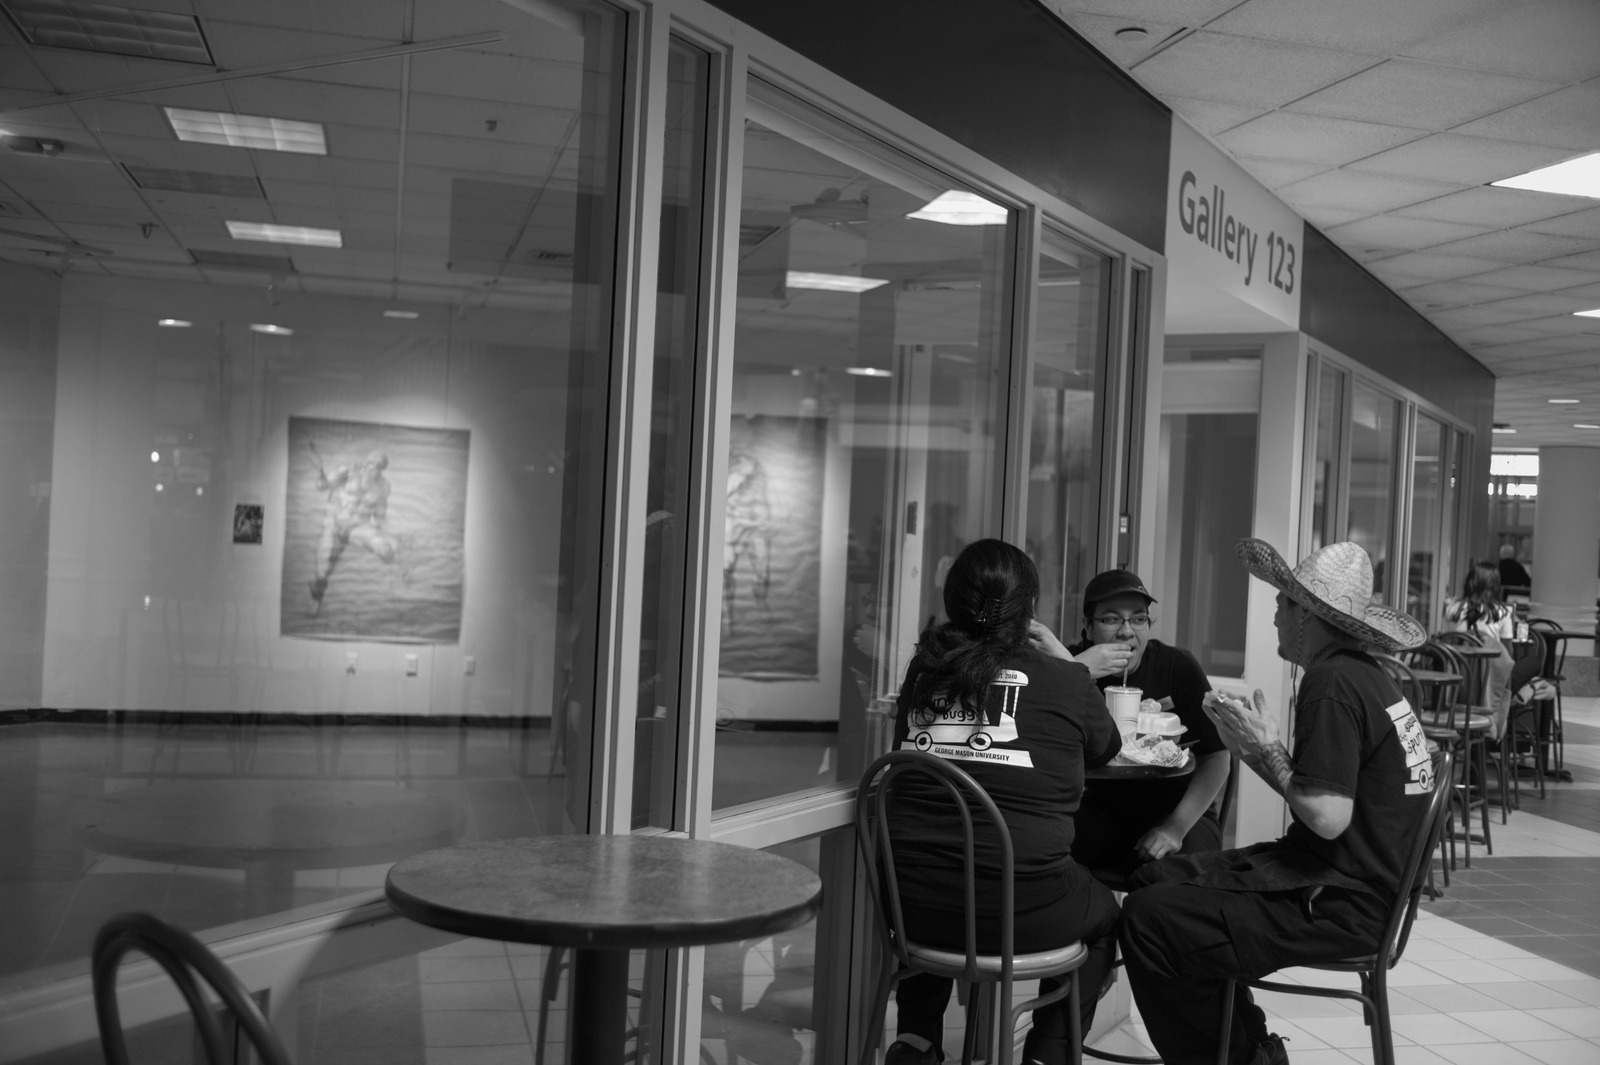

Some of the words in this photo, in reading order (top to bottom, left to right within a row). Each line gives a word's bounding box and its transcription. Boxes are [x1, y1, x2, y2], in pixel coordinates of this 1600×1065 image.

[1178, 170, 1258, 287] Gallery
[1266, 230, 1296, 295] 123
[934, 747, 955, 756] GEORGE
[955, 749, 974, 757] MASON
[975, 751, 1010, 761] UNIVERSITY
